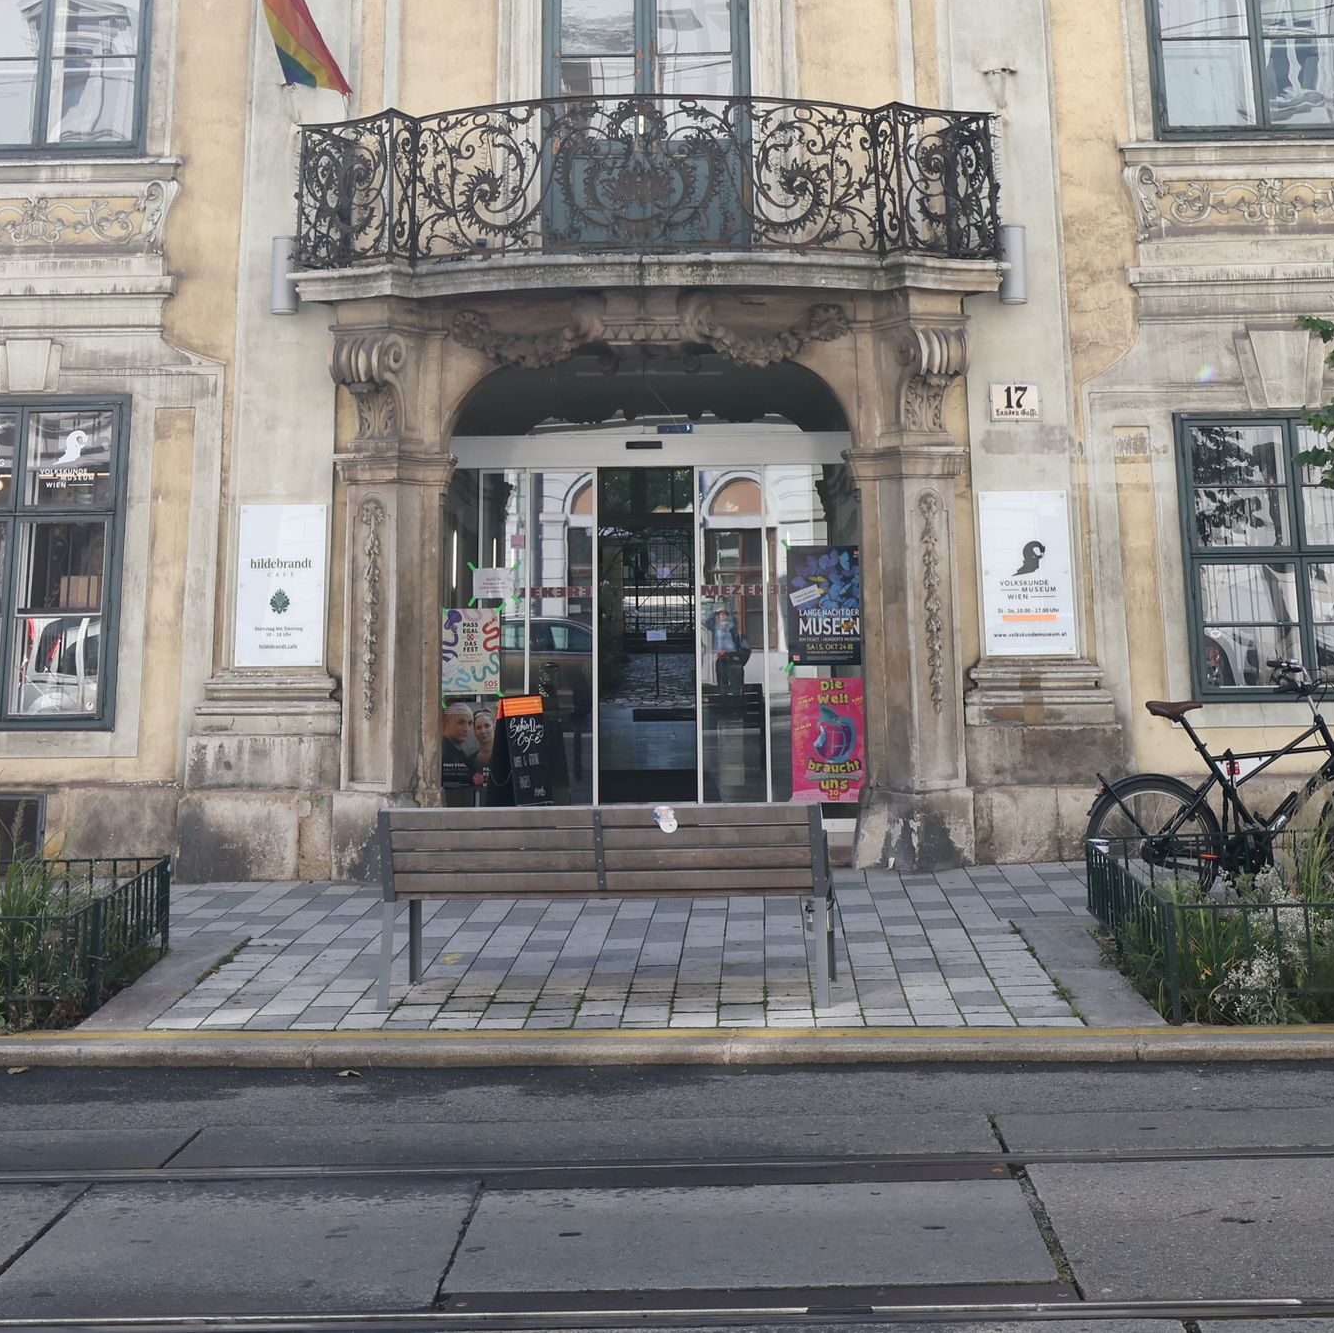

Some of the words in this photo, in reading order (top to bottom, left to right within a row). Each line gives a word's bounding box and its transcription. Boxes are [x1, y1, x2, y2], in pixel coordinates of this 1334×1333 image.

[1004, 386, 1028, 409] 17
[250, 557, 312, 569] hildebrandt
[999, 579, 1049, 587] VOLKSKUNDE
[799, 609, 822, 617] LANGE
[845, 608, 859, 616] DER
[799, 617, 860, 636] MUSEEN
[806, 643, 816, 651] SA
[820, 680, 844, 691] Die
[816, 694, 849, 705] Welt
[807, 759, 861, 773] braucht
[820, 780, 849, 790] uns
